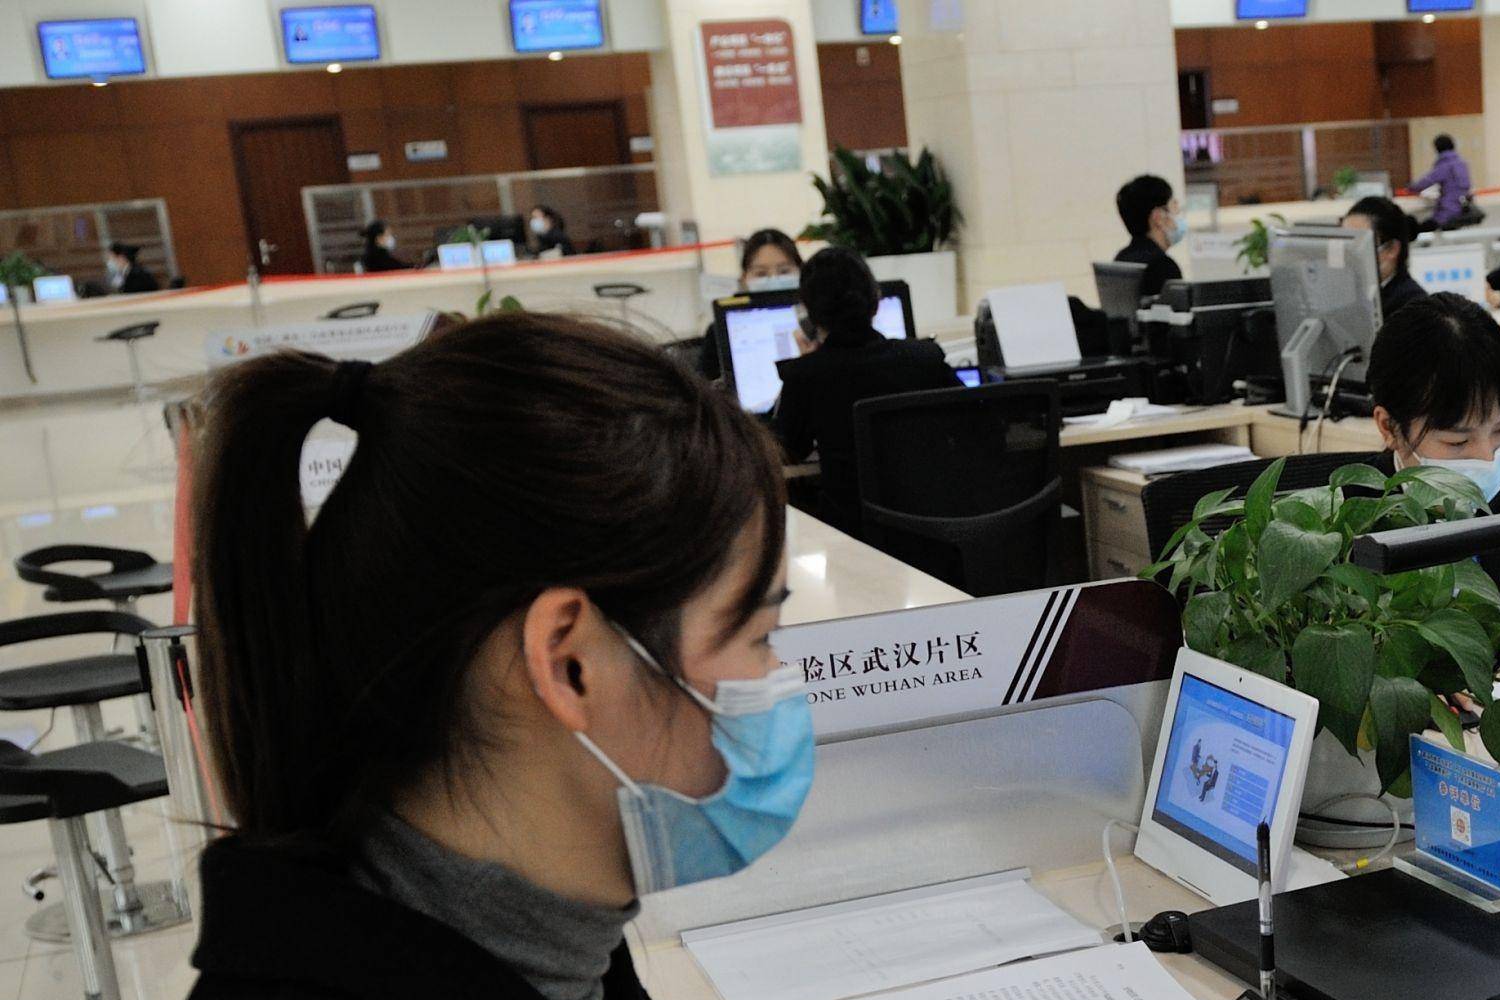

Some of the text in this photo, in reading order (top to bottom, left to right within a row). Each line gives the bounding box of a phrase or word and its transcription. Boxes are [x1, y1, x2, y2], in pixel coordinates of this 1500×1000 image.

[797, 631, 983, 683] 验区武汉片区
[806, 667, 984, 706] ONE WUHAN AREA
